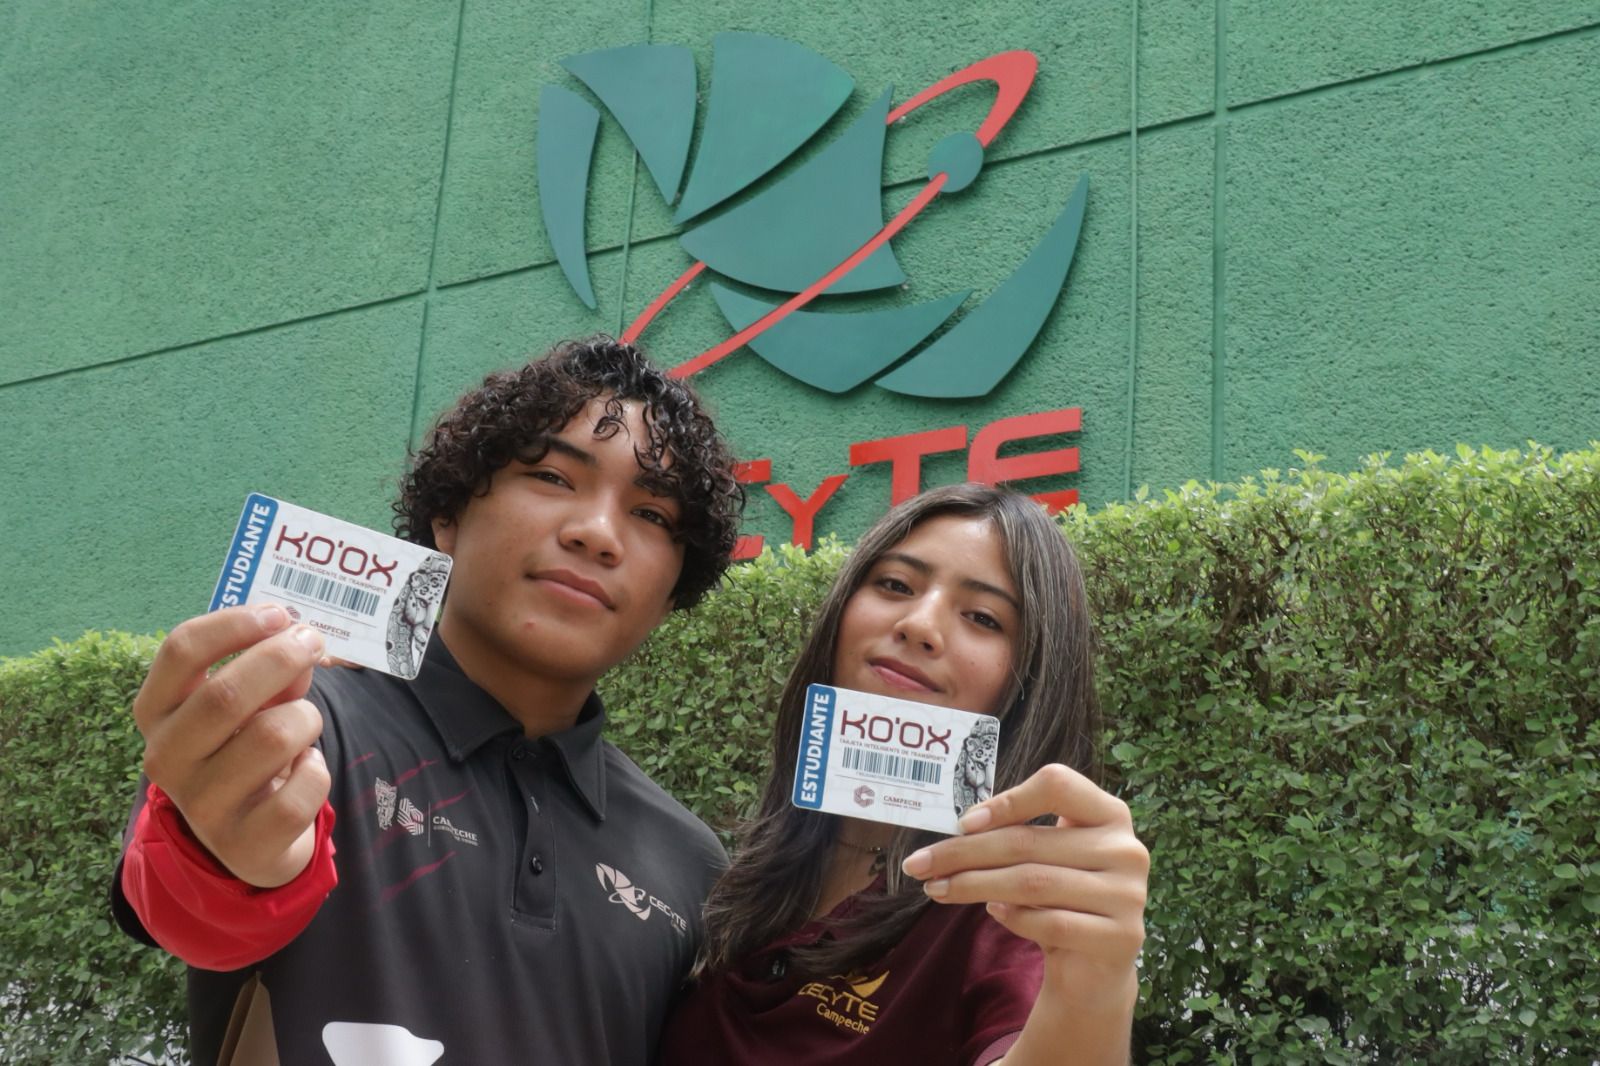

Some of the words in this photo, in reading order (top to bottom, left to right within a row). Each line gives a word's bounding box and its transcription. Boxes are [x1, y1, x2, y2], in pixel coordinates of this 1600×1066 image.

[218, 503, 270, 609] STUDIANTE
[275, 525, 398, 586] KO'OX
[309, 619, 351, 637] CAMPECHE
[801, 693, 829, 802] ESTUDIANTE
[840, 710, 951, 754] KO'OX
[883, 795, 922, 807] CAMPECHE
[649, 895, 687, 931] CECYTE
[816, 1002, 870, 1035] Campeche
